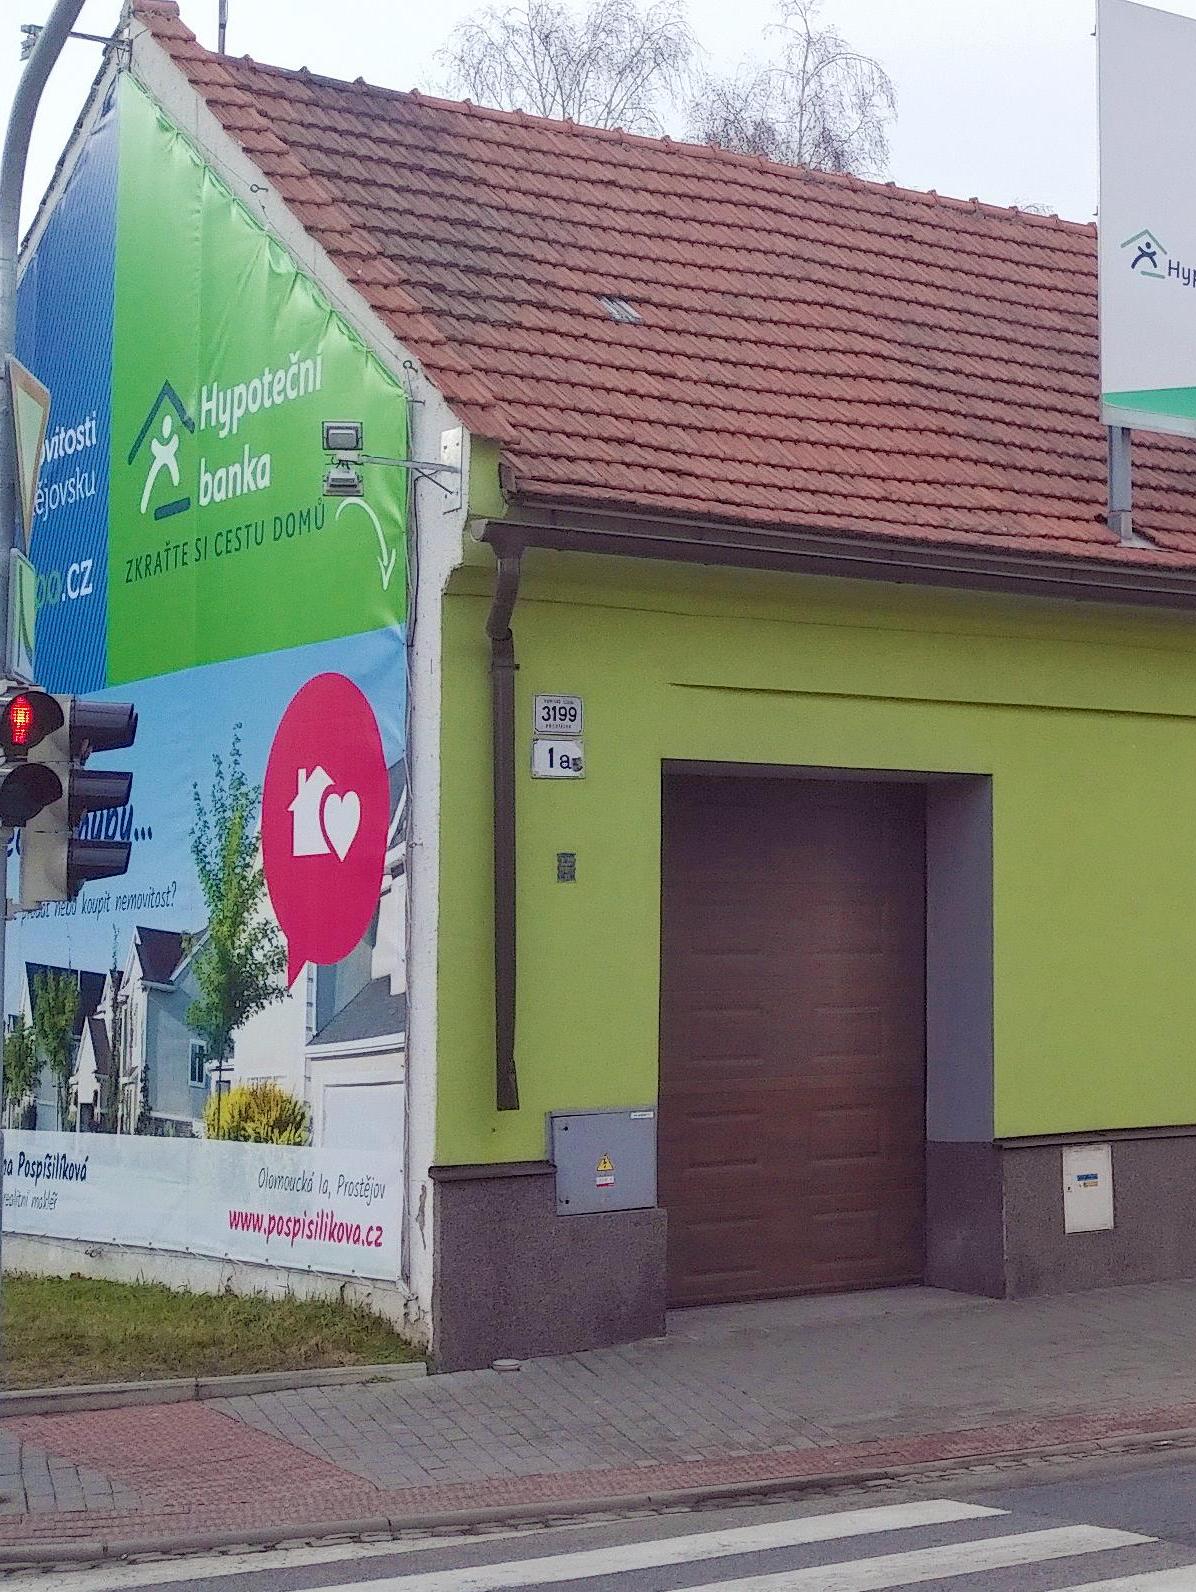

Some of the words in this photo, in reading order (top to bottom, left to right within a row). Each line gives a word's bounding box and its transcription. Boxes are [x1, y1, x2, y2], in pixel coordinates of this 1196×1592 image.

[200, 350, 323, 438] Hypoteční
[34, 466, 96, 521] ějovsku
[198, 444, 270, 506] banka
[125, 541, 188, 583] ZKRAŤTE
[195, 536, 207, 562] SI
[214, 520, 264, 557] CESTU
[273, 497, 325, 541] DOMŮ
[541, 706, 577, 722] 3199
[115, 881, 177, 910] nemovitost?
[258, 1166, 315, 1192] Olomoucká
[336, 1174, 386, 1206] Prostějov
[229, 1208, 384, 1248] www.pospisilikova.cz
